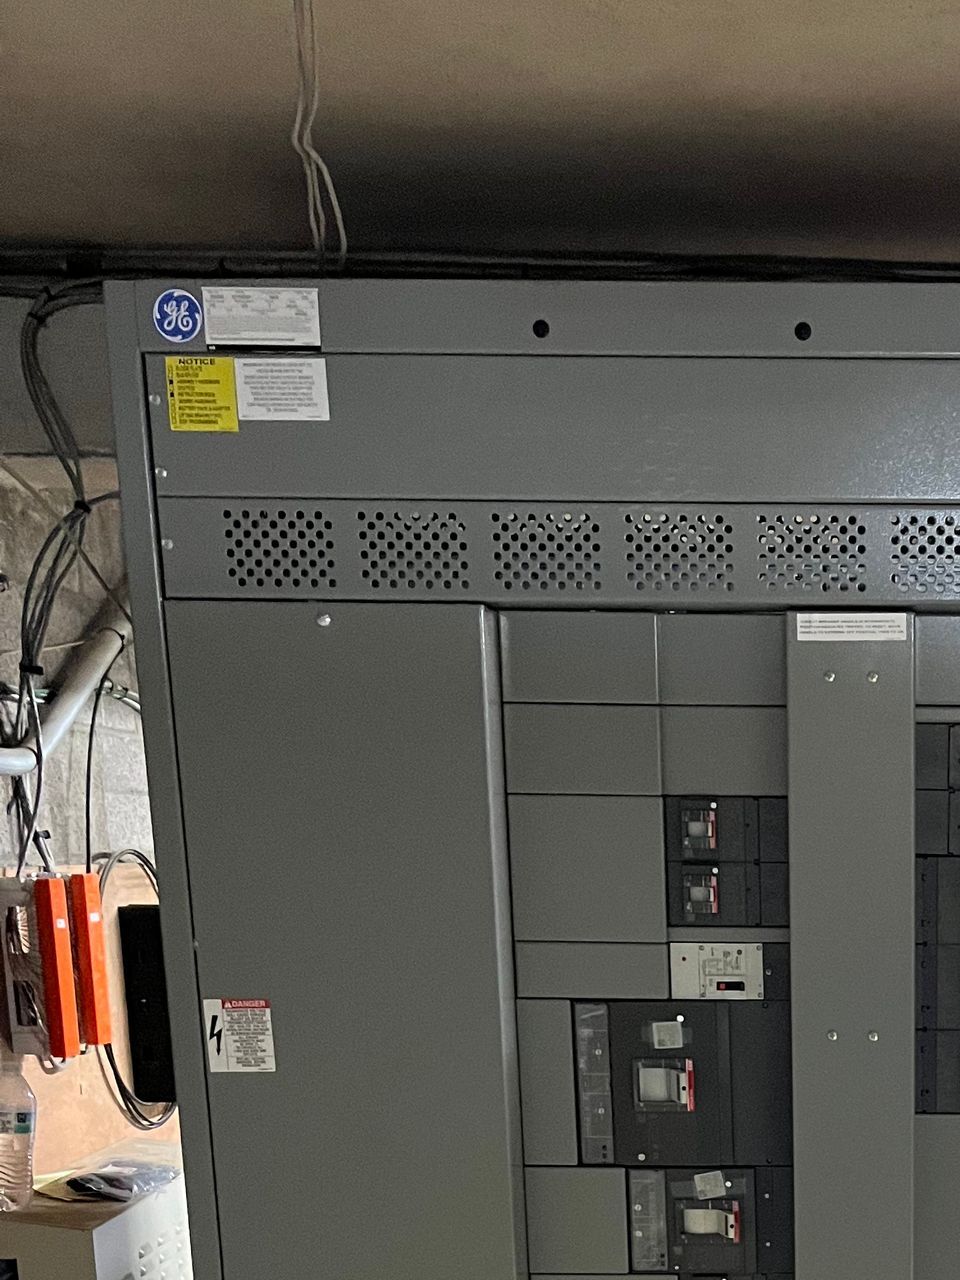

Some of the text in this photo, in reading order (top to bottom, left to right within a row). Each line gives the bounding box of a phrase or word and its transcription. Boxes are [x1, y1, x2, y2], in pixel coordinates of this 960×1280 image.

[163, 300, 193, 331] GE
[178, 358, 216, 366] NOTICE
[231, 1000, 266, 1008] DANGER
